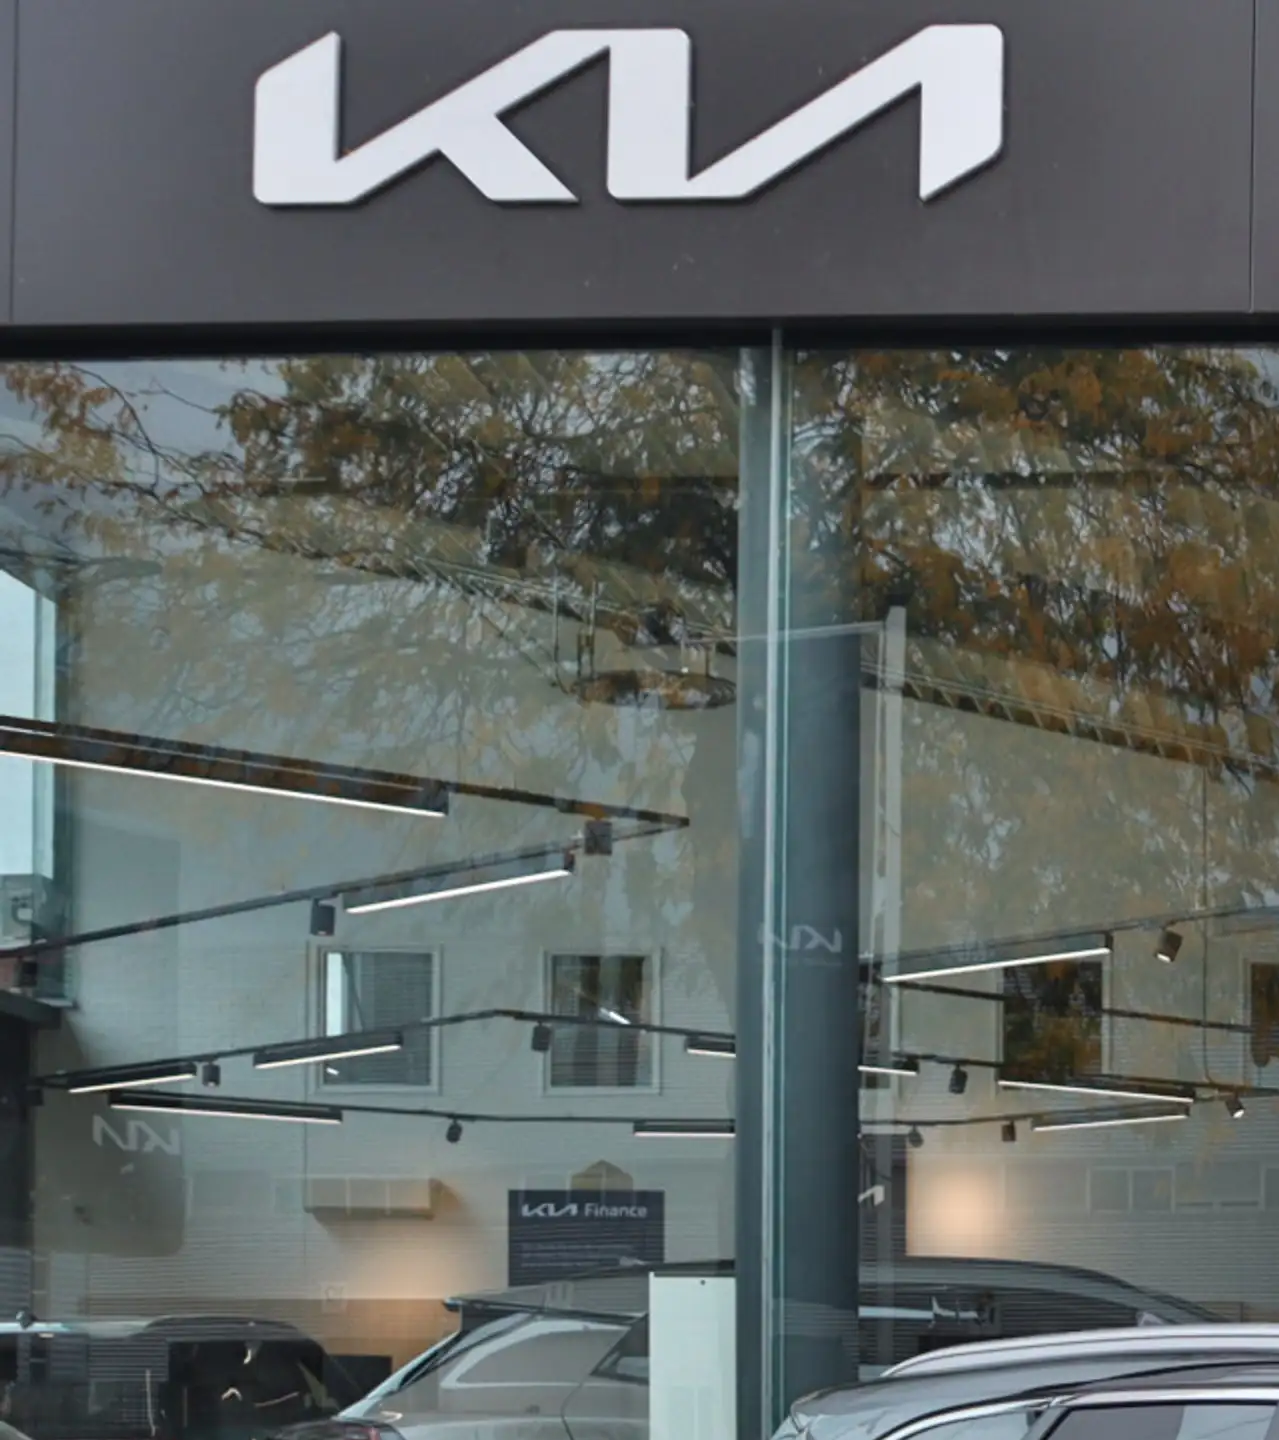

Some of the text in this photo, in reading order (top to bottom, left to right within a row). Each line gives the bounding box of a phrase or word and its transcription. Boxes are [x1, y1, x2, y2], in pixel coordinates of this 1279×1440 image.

[252, 23, 1006, 206] KIA
[521, 1202, 648, 1218] KIA Finance
